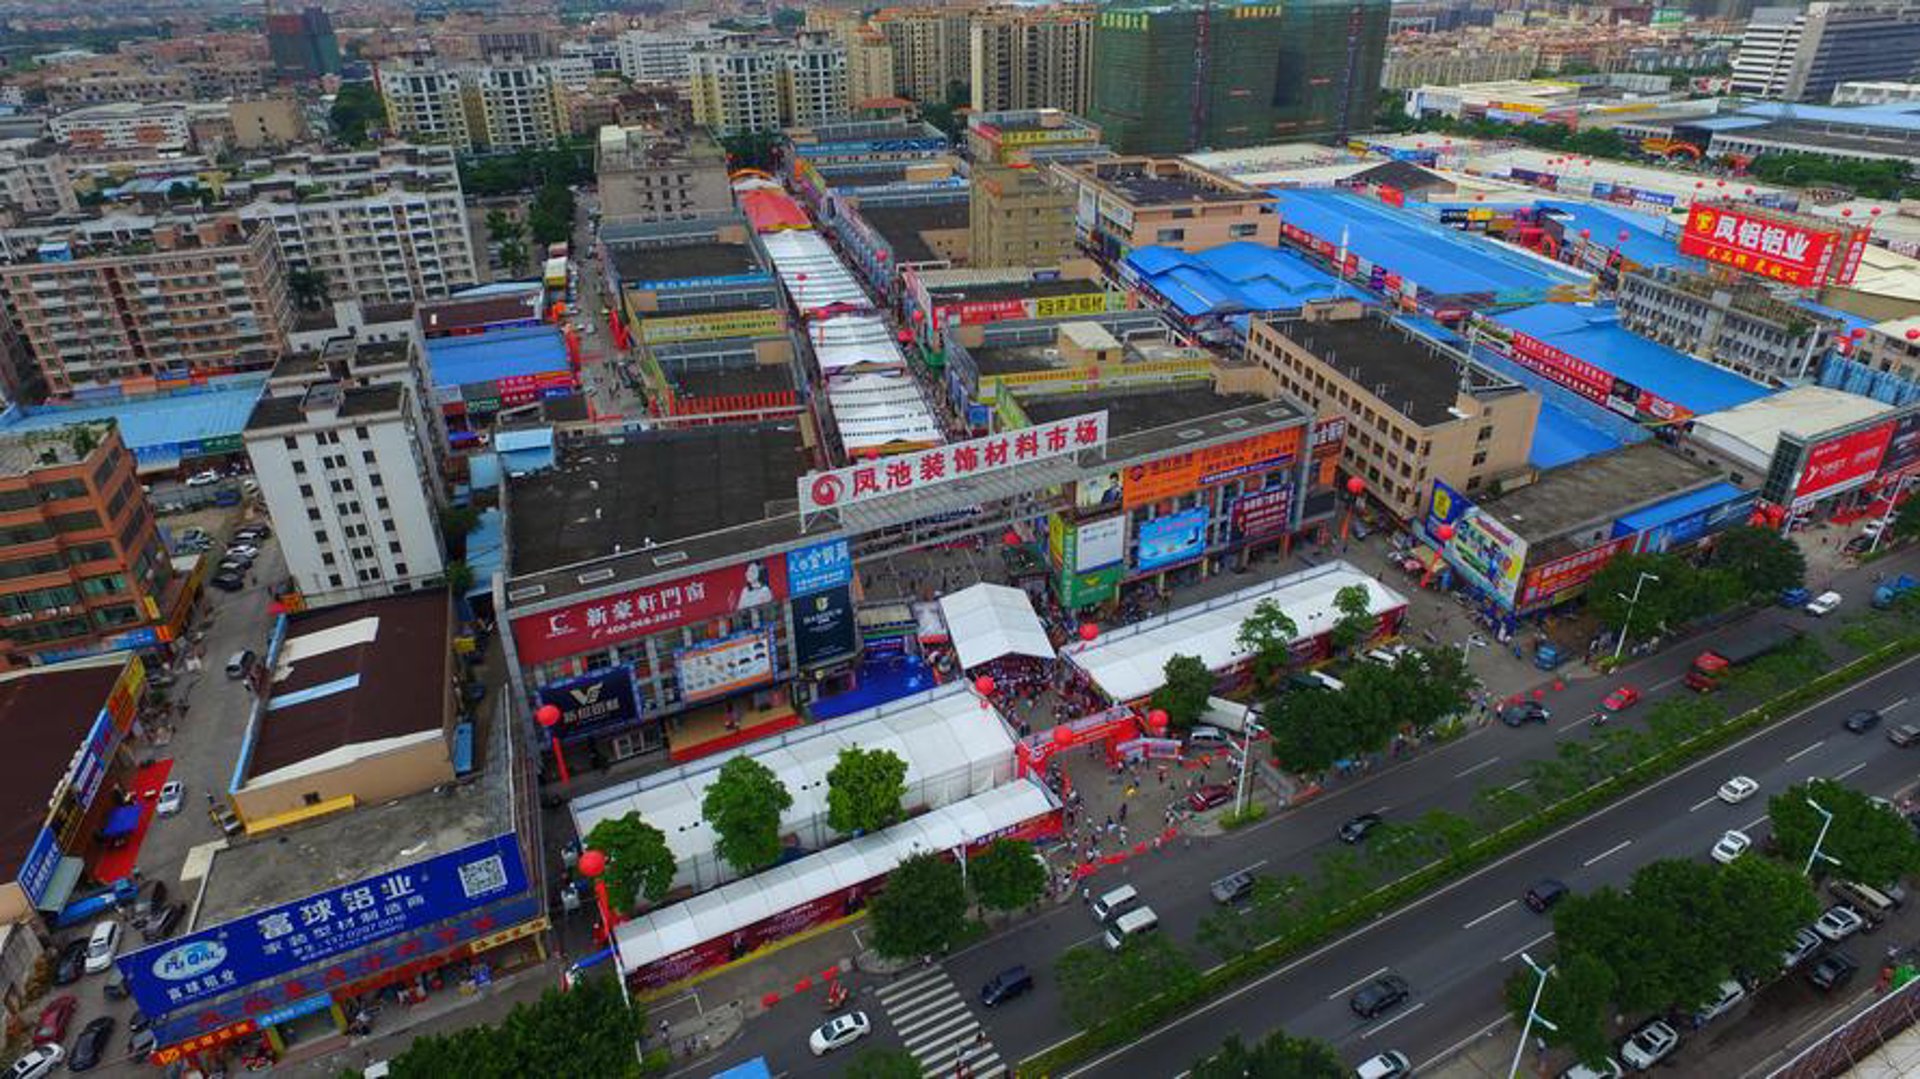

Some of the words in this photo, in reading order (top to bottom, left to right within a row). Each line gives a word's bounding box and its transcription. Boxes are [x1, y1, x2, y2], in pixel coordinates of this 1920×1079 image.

[1713, 214, 1810, 262] 凤铝铝业
[852, 417, 1099, 497] 凤池装饰材料市场
[257, 874, 416, 939] 富球铝业
